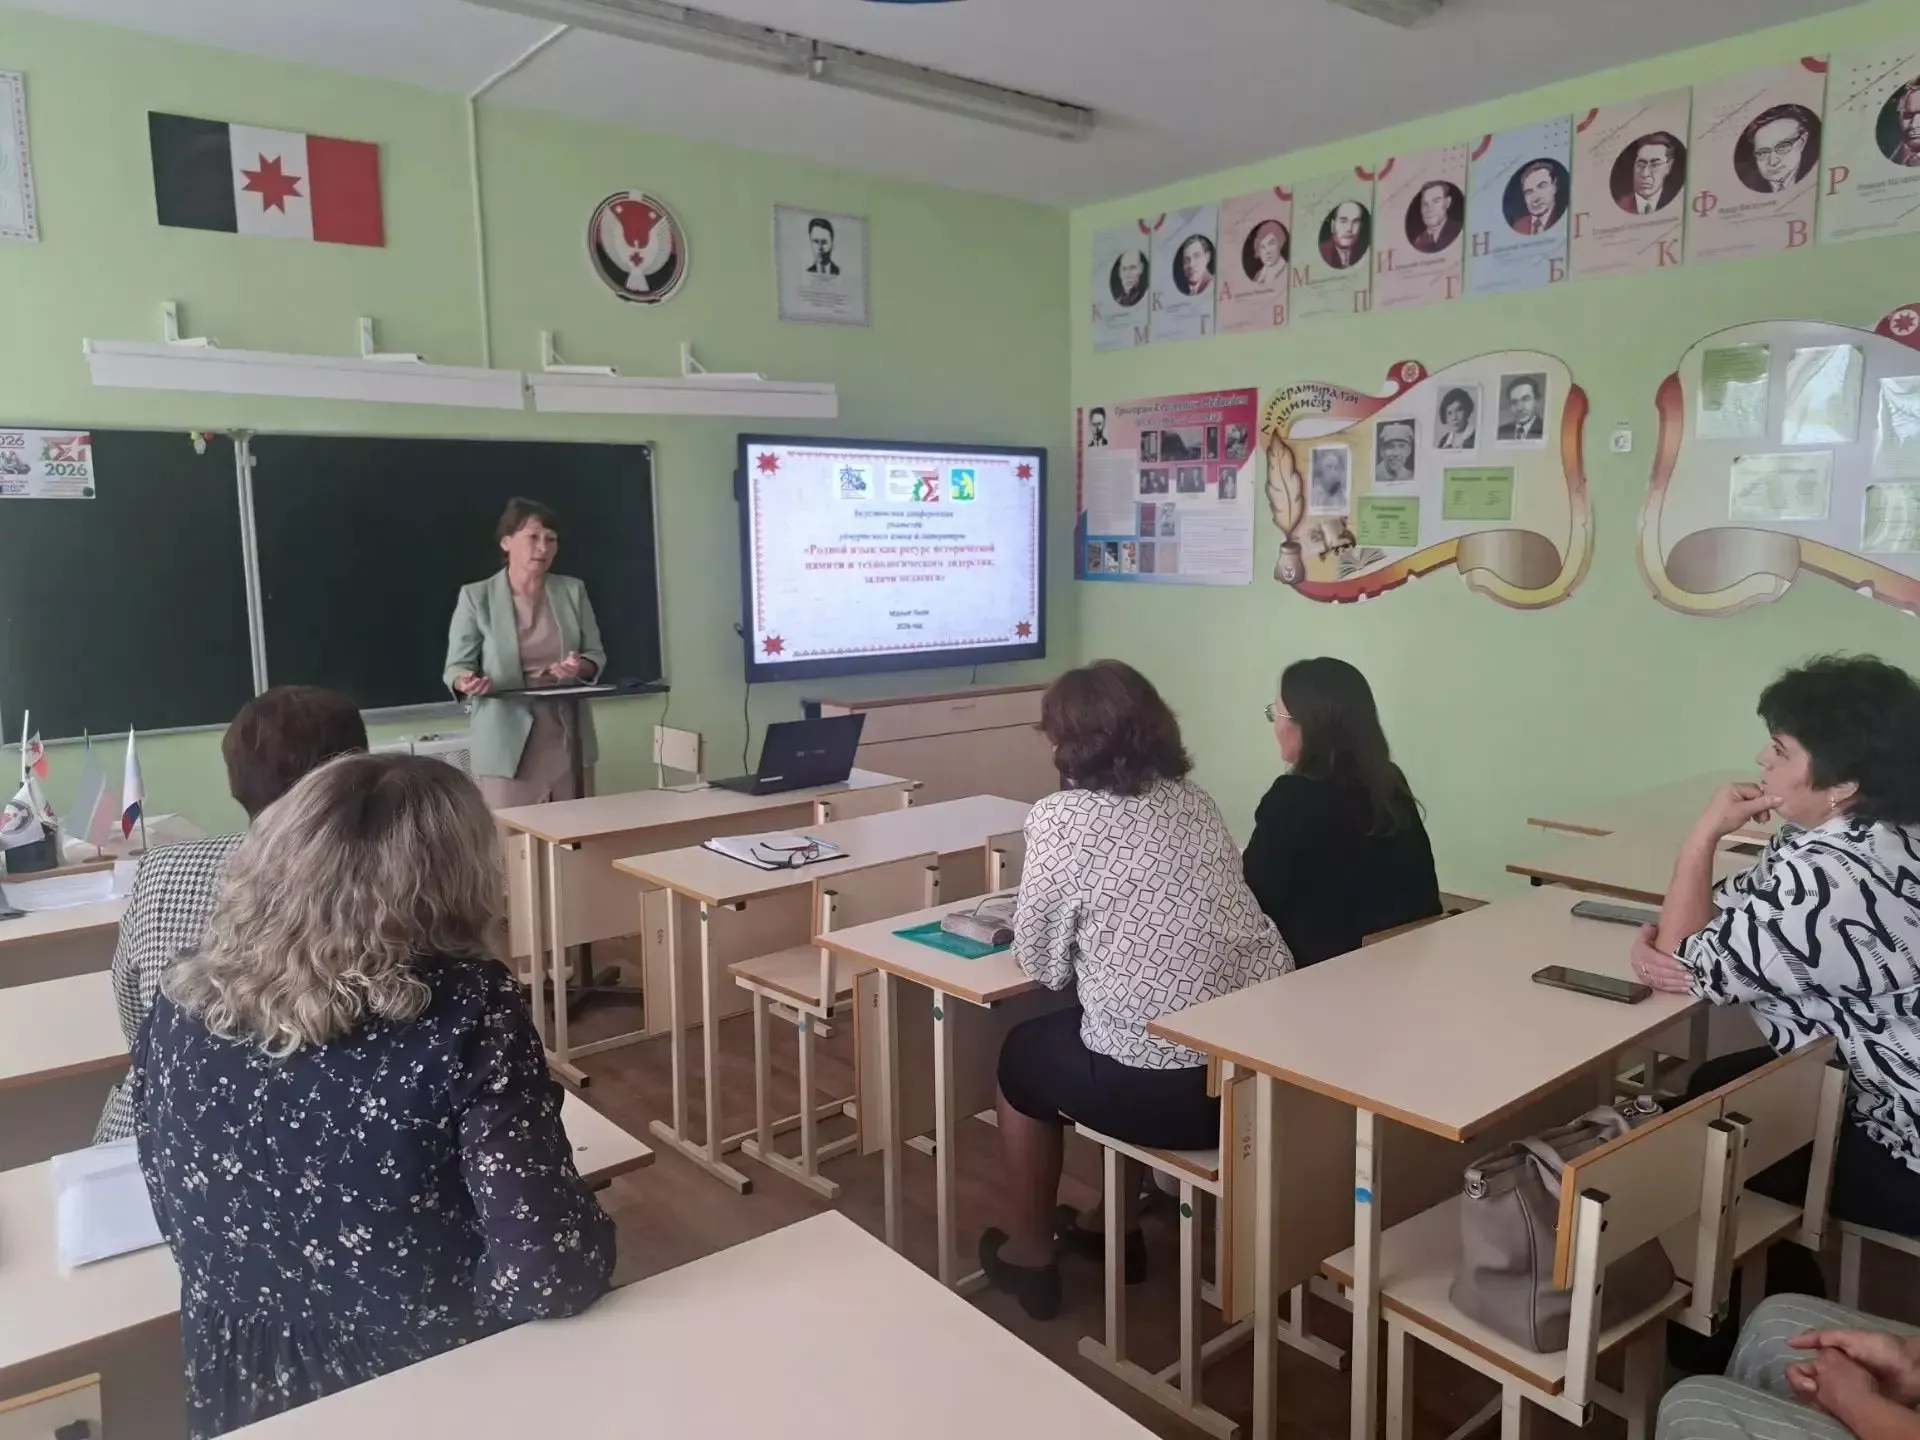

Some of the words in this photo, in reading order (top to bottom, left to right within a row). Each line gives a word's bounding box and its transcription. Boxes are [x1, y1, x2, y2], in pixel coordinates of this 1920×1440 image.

[1826, 165, 1850, 196] Р
[1692, 190, 1718, 218] Ф
[1574, 211, 1590, 239] Г
[1785, 219, 1808, 248] В
[1472, 231, 1490, 257] Н
[1656, 238, 1678, 267] К
[1292, 264, 1310, 288] М
[1548, 257, 1565, 284] Б
[1219, 281, 1232, 301] А
[1445, 275, 1460, 300] Г
[1152, 292, 1164, 311] К
[1353, 290, 1372, 314] П
[1272, 304, 1285, 326] В
[1133, 325, 1150, 346] М
[44, 463, 88, 477] 2026
